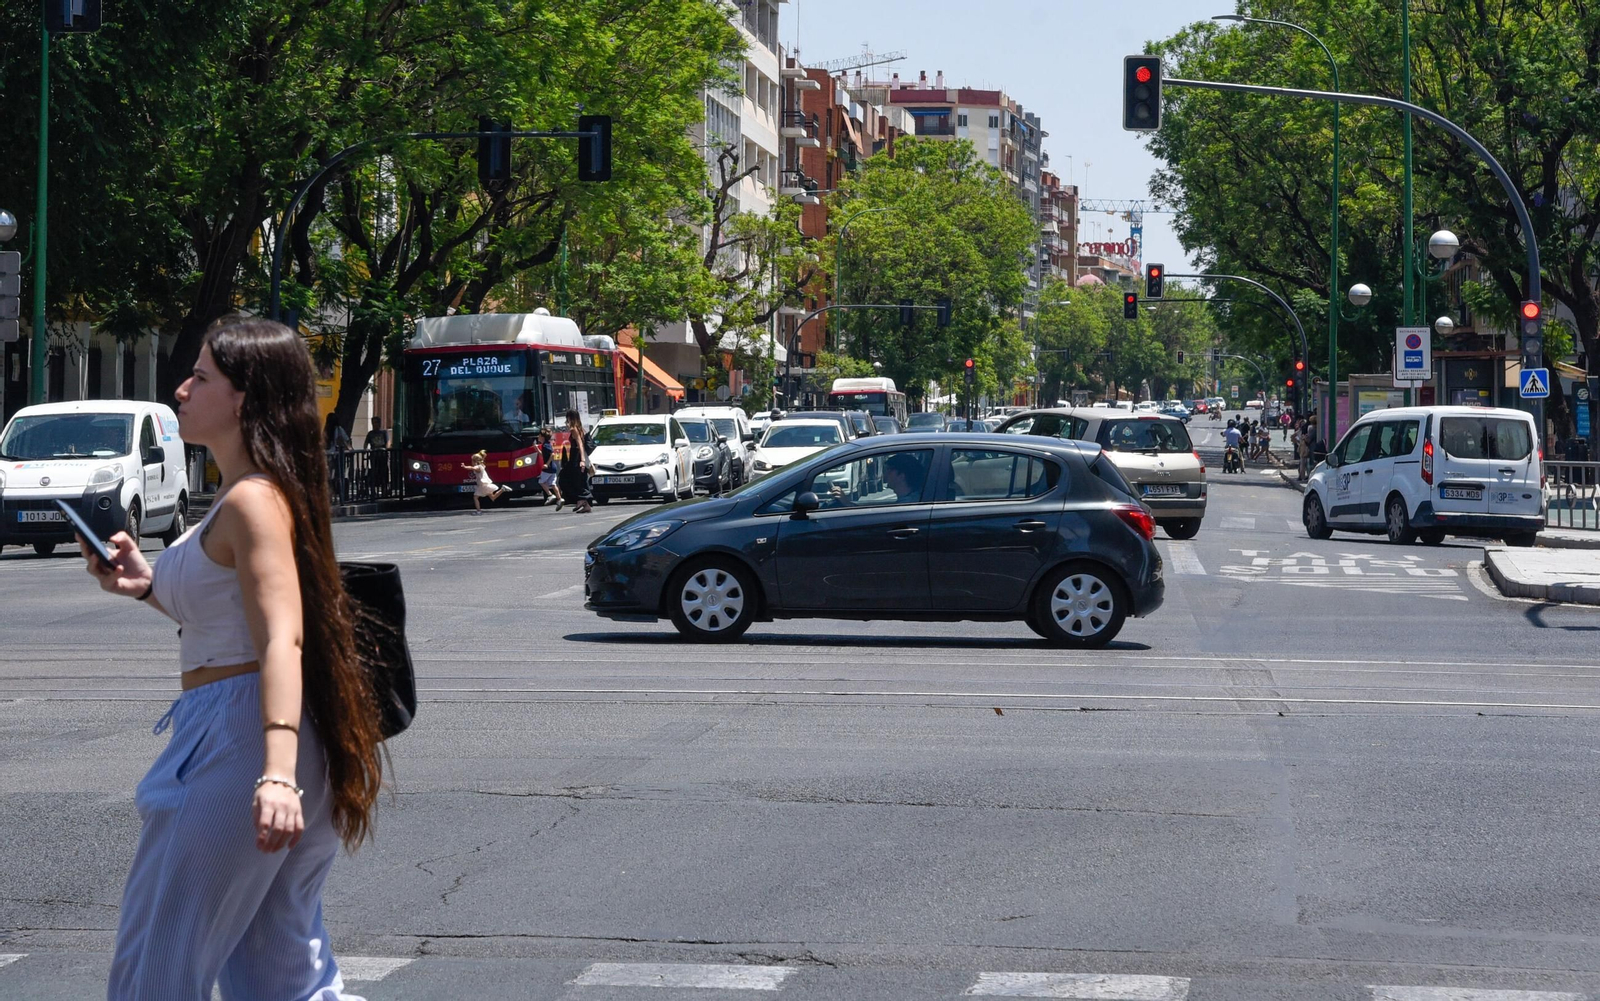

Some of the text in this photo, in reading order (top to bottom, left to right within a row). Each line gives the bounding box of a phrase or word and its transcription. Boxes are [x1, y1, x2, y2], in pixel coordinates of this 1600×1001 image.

[462, 356, 498, 366] PLAZA
[422, 360, 442, 376] 27
[450, 366, 472, 375] DEL
[438, 463, 452, 471] 249
[25, 512, 64, 520] 1013 JD
[1228, 548, 1425, 561] TAXI
[1219, 566, 1459, 577] SOLO
